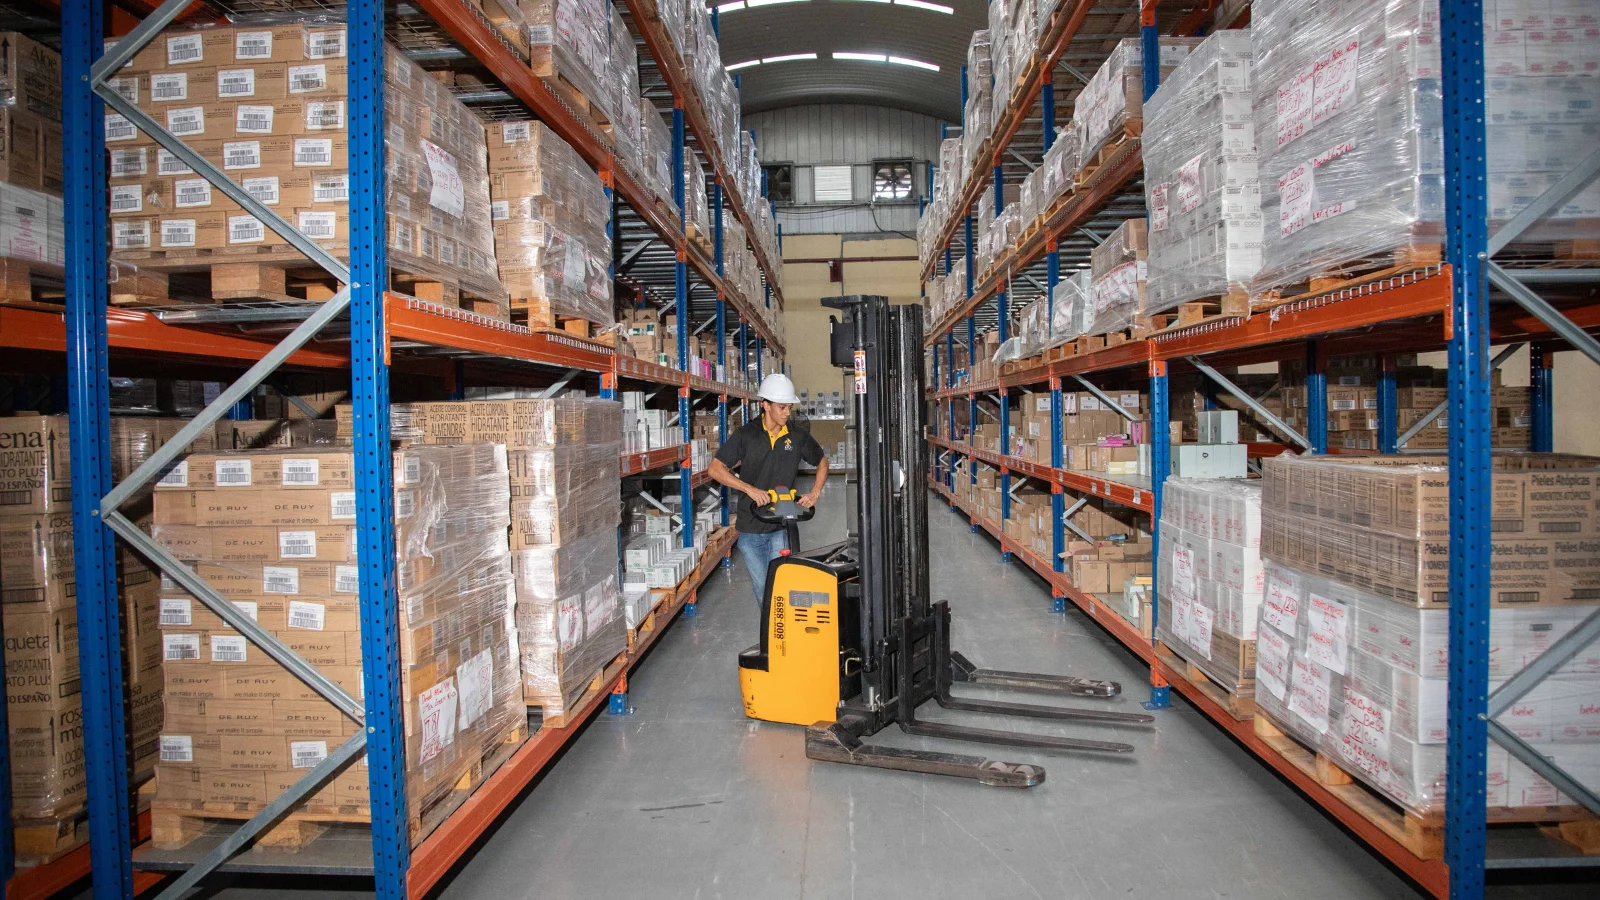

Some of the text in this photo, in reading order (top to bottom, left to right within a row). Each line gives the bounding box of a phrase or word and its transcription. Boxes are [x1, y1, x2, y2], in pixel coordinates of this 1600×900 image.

[31, 45, 57, 68] Aloe
[429, 405, 467, 413] ACEITE CORPORAL
[470, 403, 509, 417] ACEITE CORPORAL
[430, 413, 467, 422] HIDRATANTE
[471, 416, 510, 432] HIDRATANTE
[430, 422, 466, 437] ALMENDRAS
[0, 431, 44, 449] ena
[0, 450, 45, 468] IDRATANTE
[1421, 479, 1445, 488] Pieles
[1531, 473, 1590, 489] Pieles Atópicas
[1424, 543, 1447, 555] Pieles
[1514, 542, 1548, 557] Atópicas
[1554, 541, 1577, 554] Pieles
[776, 595, 784, 640] 800-8899
[1512, 706, 1534, 716] bebe
